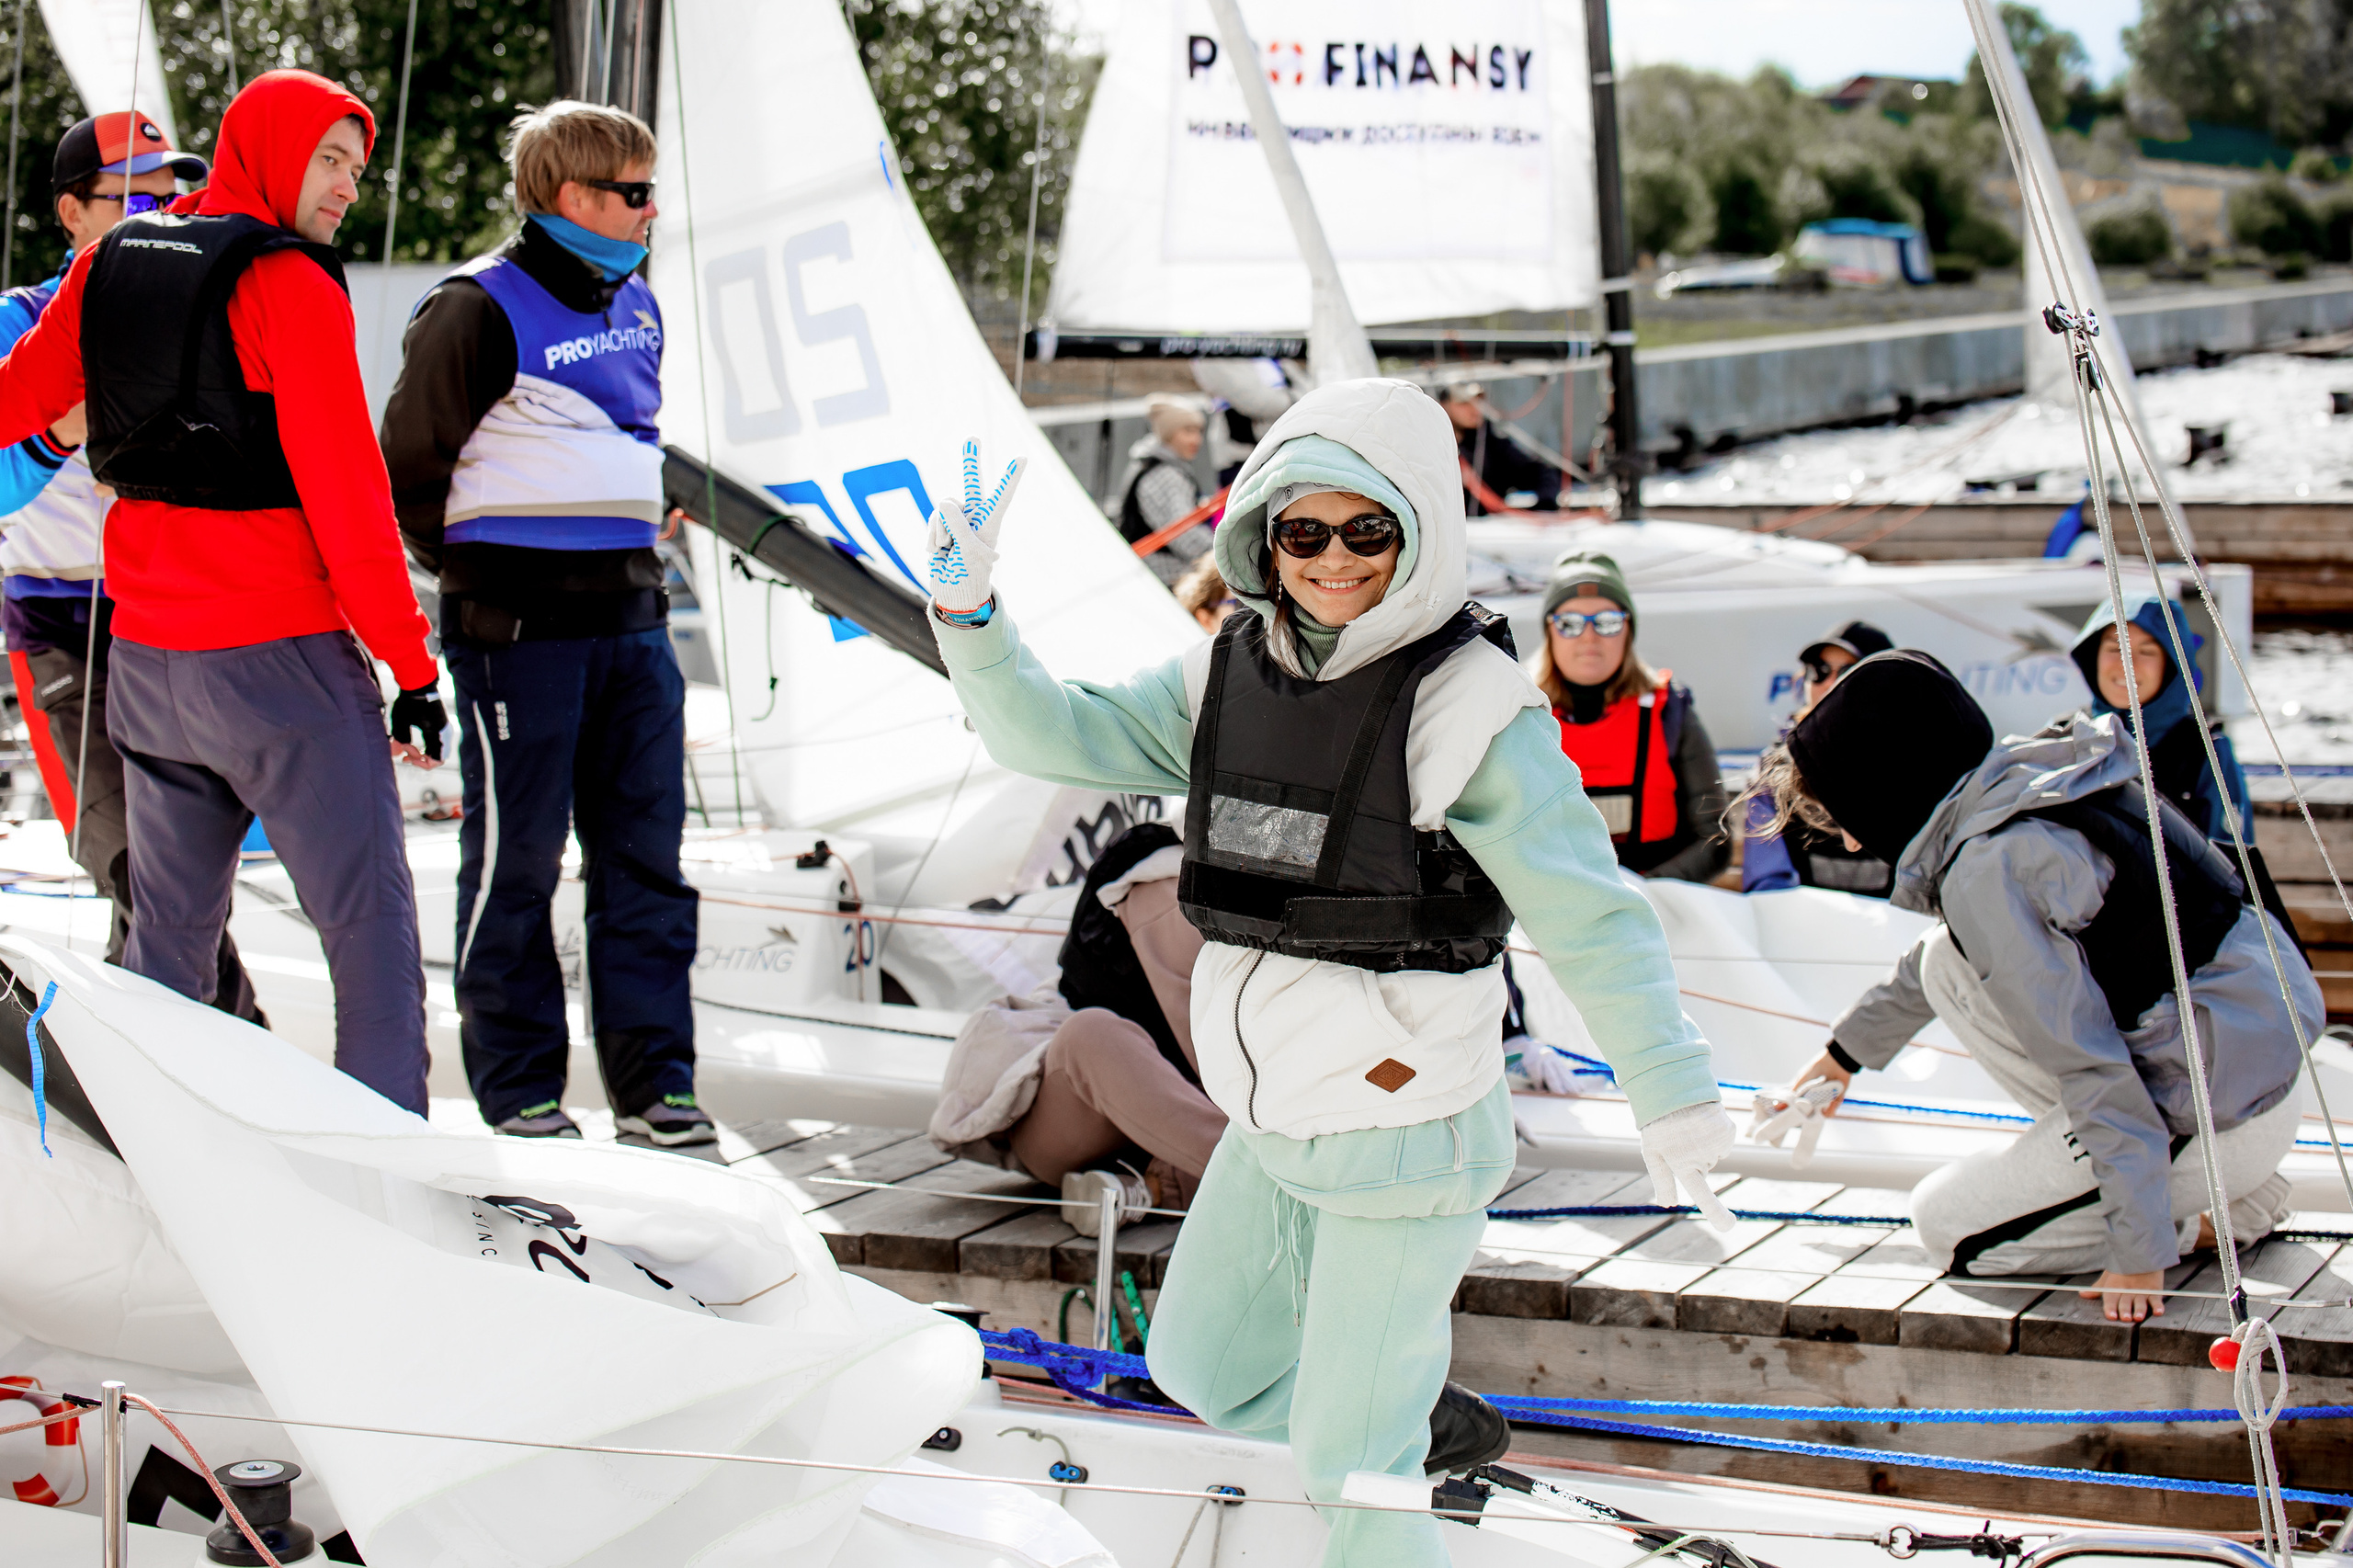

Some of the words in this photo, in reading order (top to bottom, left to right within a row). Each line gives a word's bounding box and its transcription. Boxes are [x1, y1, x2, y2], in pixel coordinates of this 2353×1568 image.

[544, 326, 662, 370] PROYACHTING
[694, 945, 795, 973] CHTING
[844, 920, 874, 973] 20
